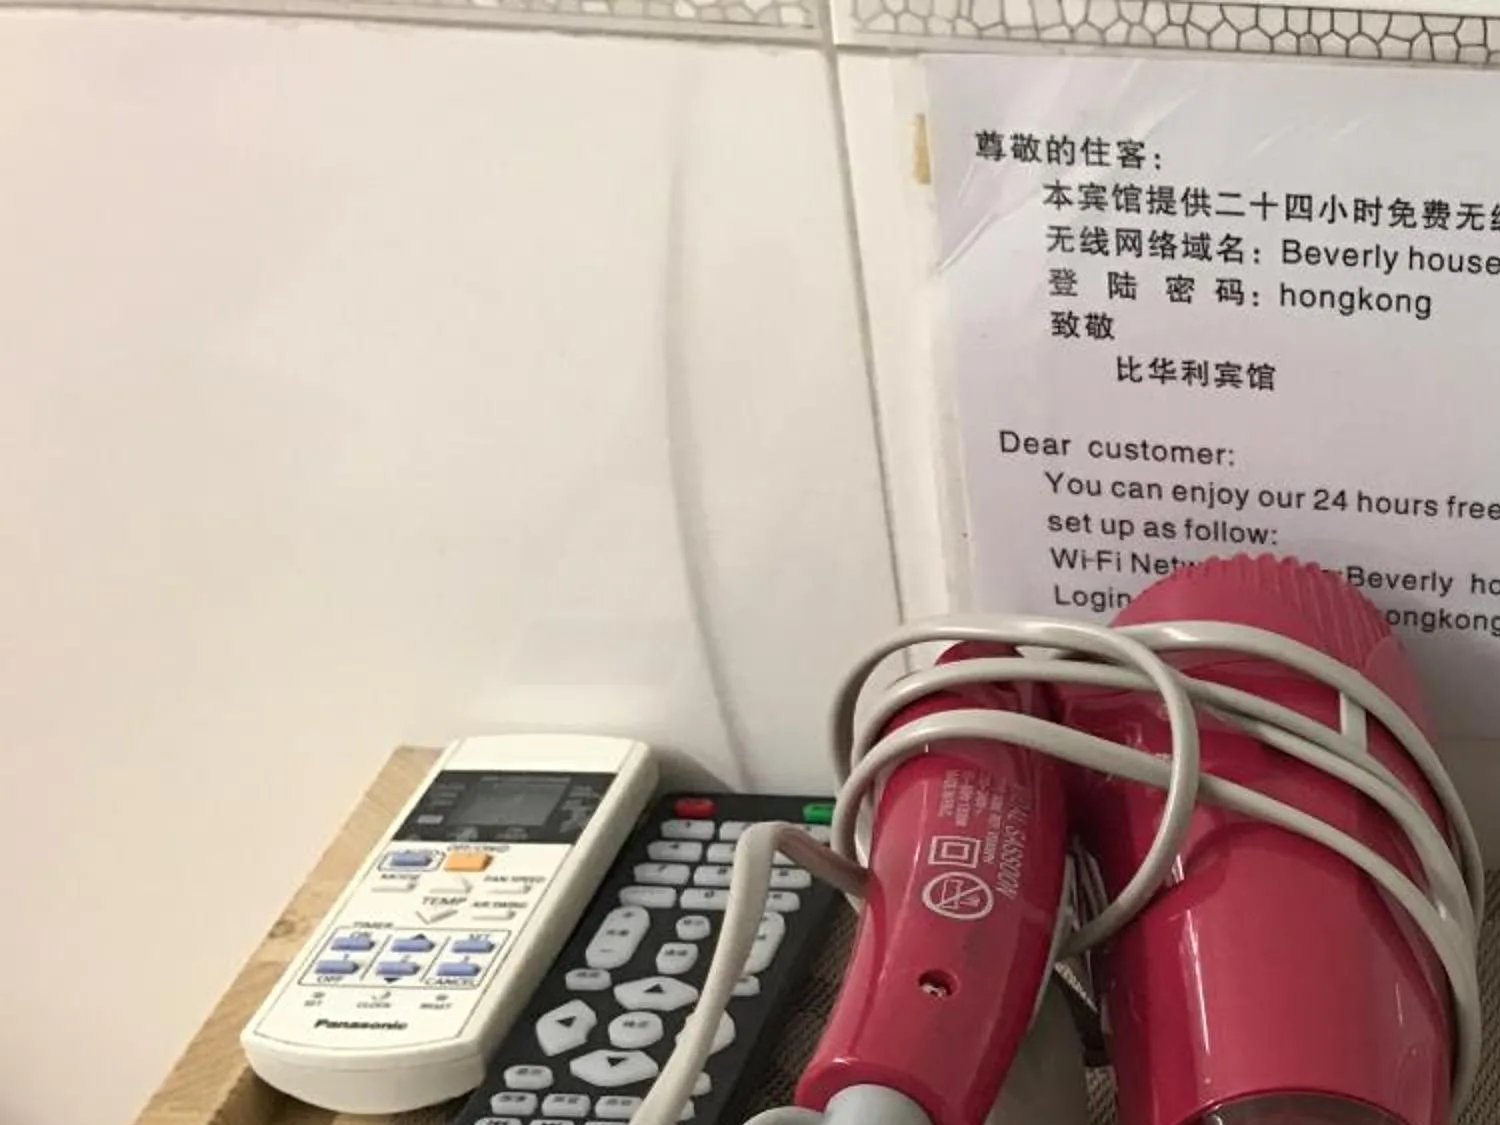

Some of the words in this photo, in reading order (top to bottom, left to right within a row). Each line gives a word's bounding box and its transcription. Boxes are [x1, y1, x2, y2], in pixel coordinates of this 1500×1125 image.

[1282, 238, 1399, 275] Beverly
[1280, 282, 1432, 320] hongkong
[1050, 310, 1115, 341] 致敬
[1116, 355, 1277, 392] 比华利宾馆
[999, 429, 1072, 456] Dear
[1088, 439, 1234, 467] customer:
[1044, 471, 1102, 496] You
[1111, 481, 1163, 500] can
[1171, 482, 1249, 511] enjoy
[1258, 490, 1306, 509] our
[1313, 488, 1348, 511] 24
[1357, 490, 1438, 517] hours
[1047, 513, 1092, 534] set
[1101, 518, 1135, 541] up
[1143, 521, 1177, 539] as
[1184, 518, 1277, 545] follow:
[1131, 552, 1203, 574] Net
[1346, 565, 1453, 597] Beverly
[1054, 584, 1132, 613] Login
[422, 897, 467, 905] TEMP
[314, 1018, 408, 1030] Panasonic
